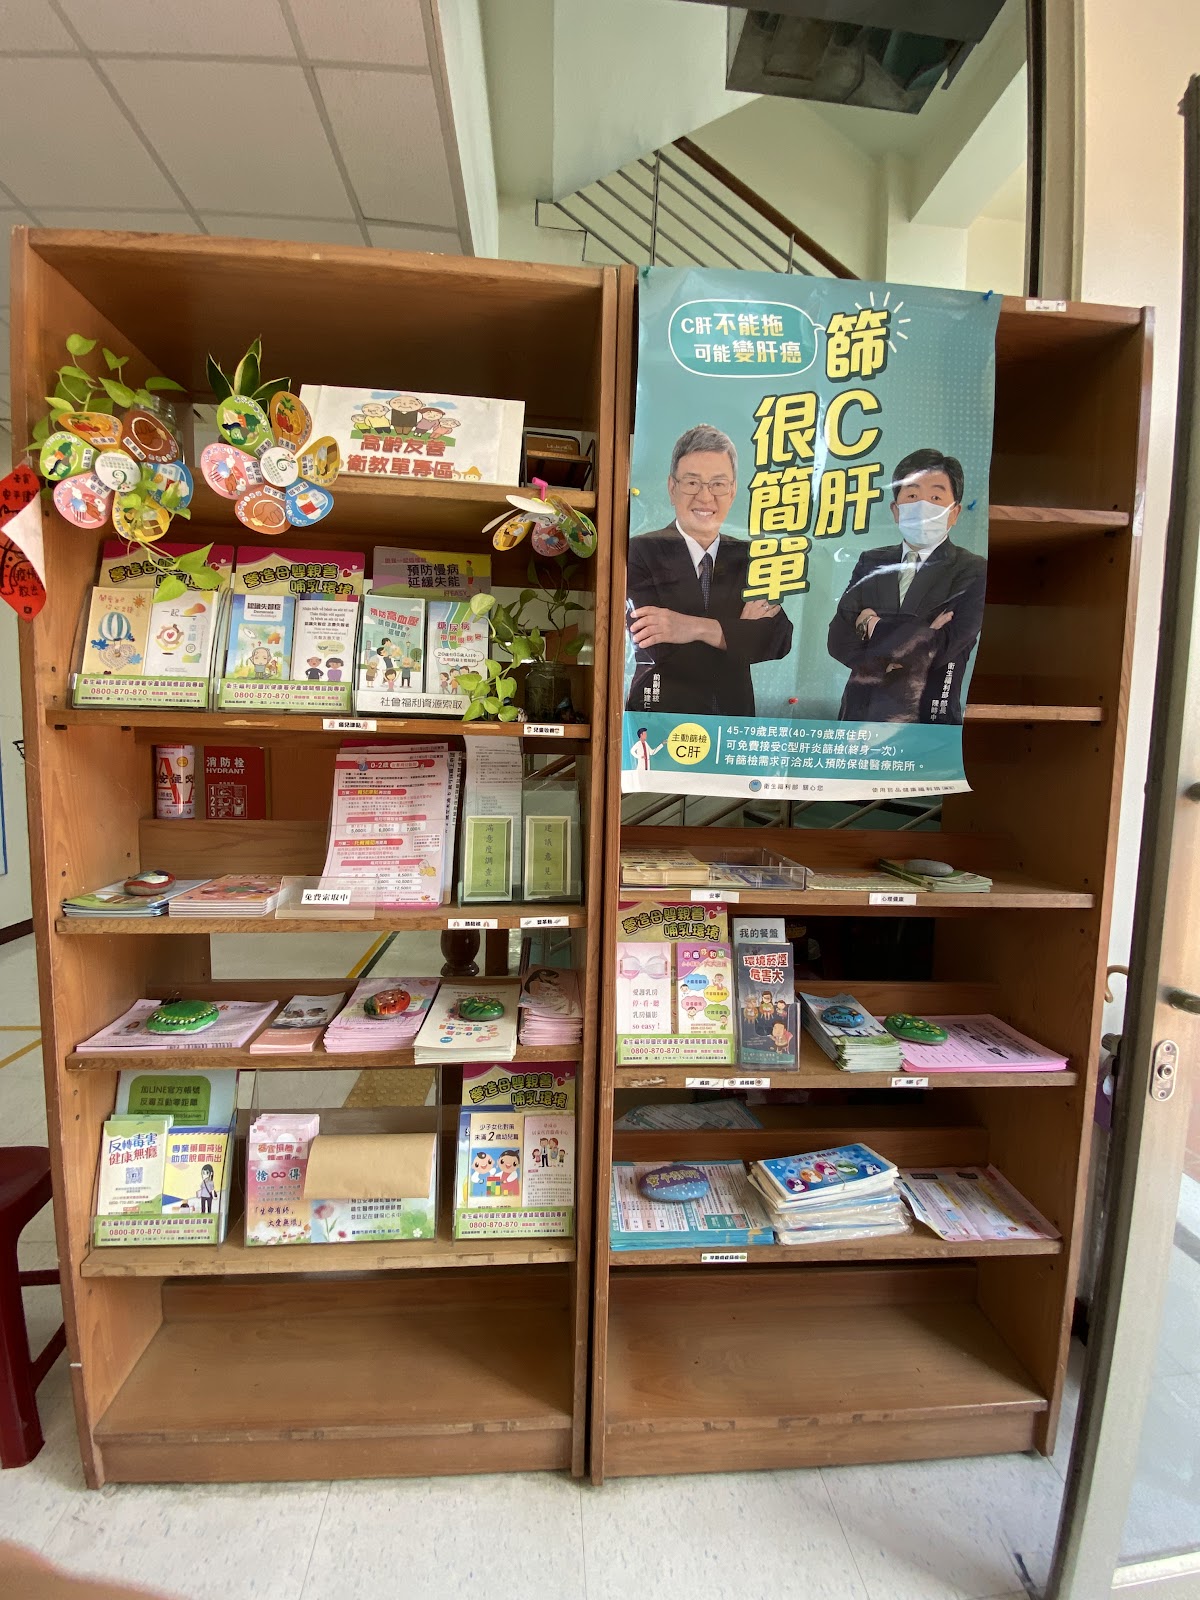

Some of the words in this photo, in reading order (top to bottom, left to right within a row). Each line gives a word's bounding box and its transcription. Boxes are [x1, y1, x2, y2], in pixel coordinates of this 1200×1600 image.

[681, 312, 784, 338] C肝不能拖
[694, 340, 802, 364] 可能變肝癌
[814, 308, 891, 538] 篩C肝
[360, 433, 447, 457] 高齡友善
[346, 454, 454, 479] 衛教單專區
[742, 391, 822, 606] 很簡單
[407, 563, 460, 577] 預防慢病
[91, 688, 149, 696] 0800-870-870
[234, 691, 290, 700] 0800-870-870
[380, 696, 464, 710] 社會福利資源索取
[675, 745, 702, 759] C肝
[206, 756, 245, 768] 消防栓
[205, 767, 245, 775] HYDRANT
[739, 928, 779, 939] 我的餐盤
[749, 968, 785, 984] 危害大
[630, 1047, 680, 1055] 0800-870-870
[109, 1228, 162, 1236] 0800-870-870
[469, 1221, 519, 1229] 0800-870-870
